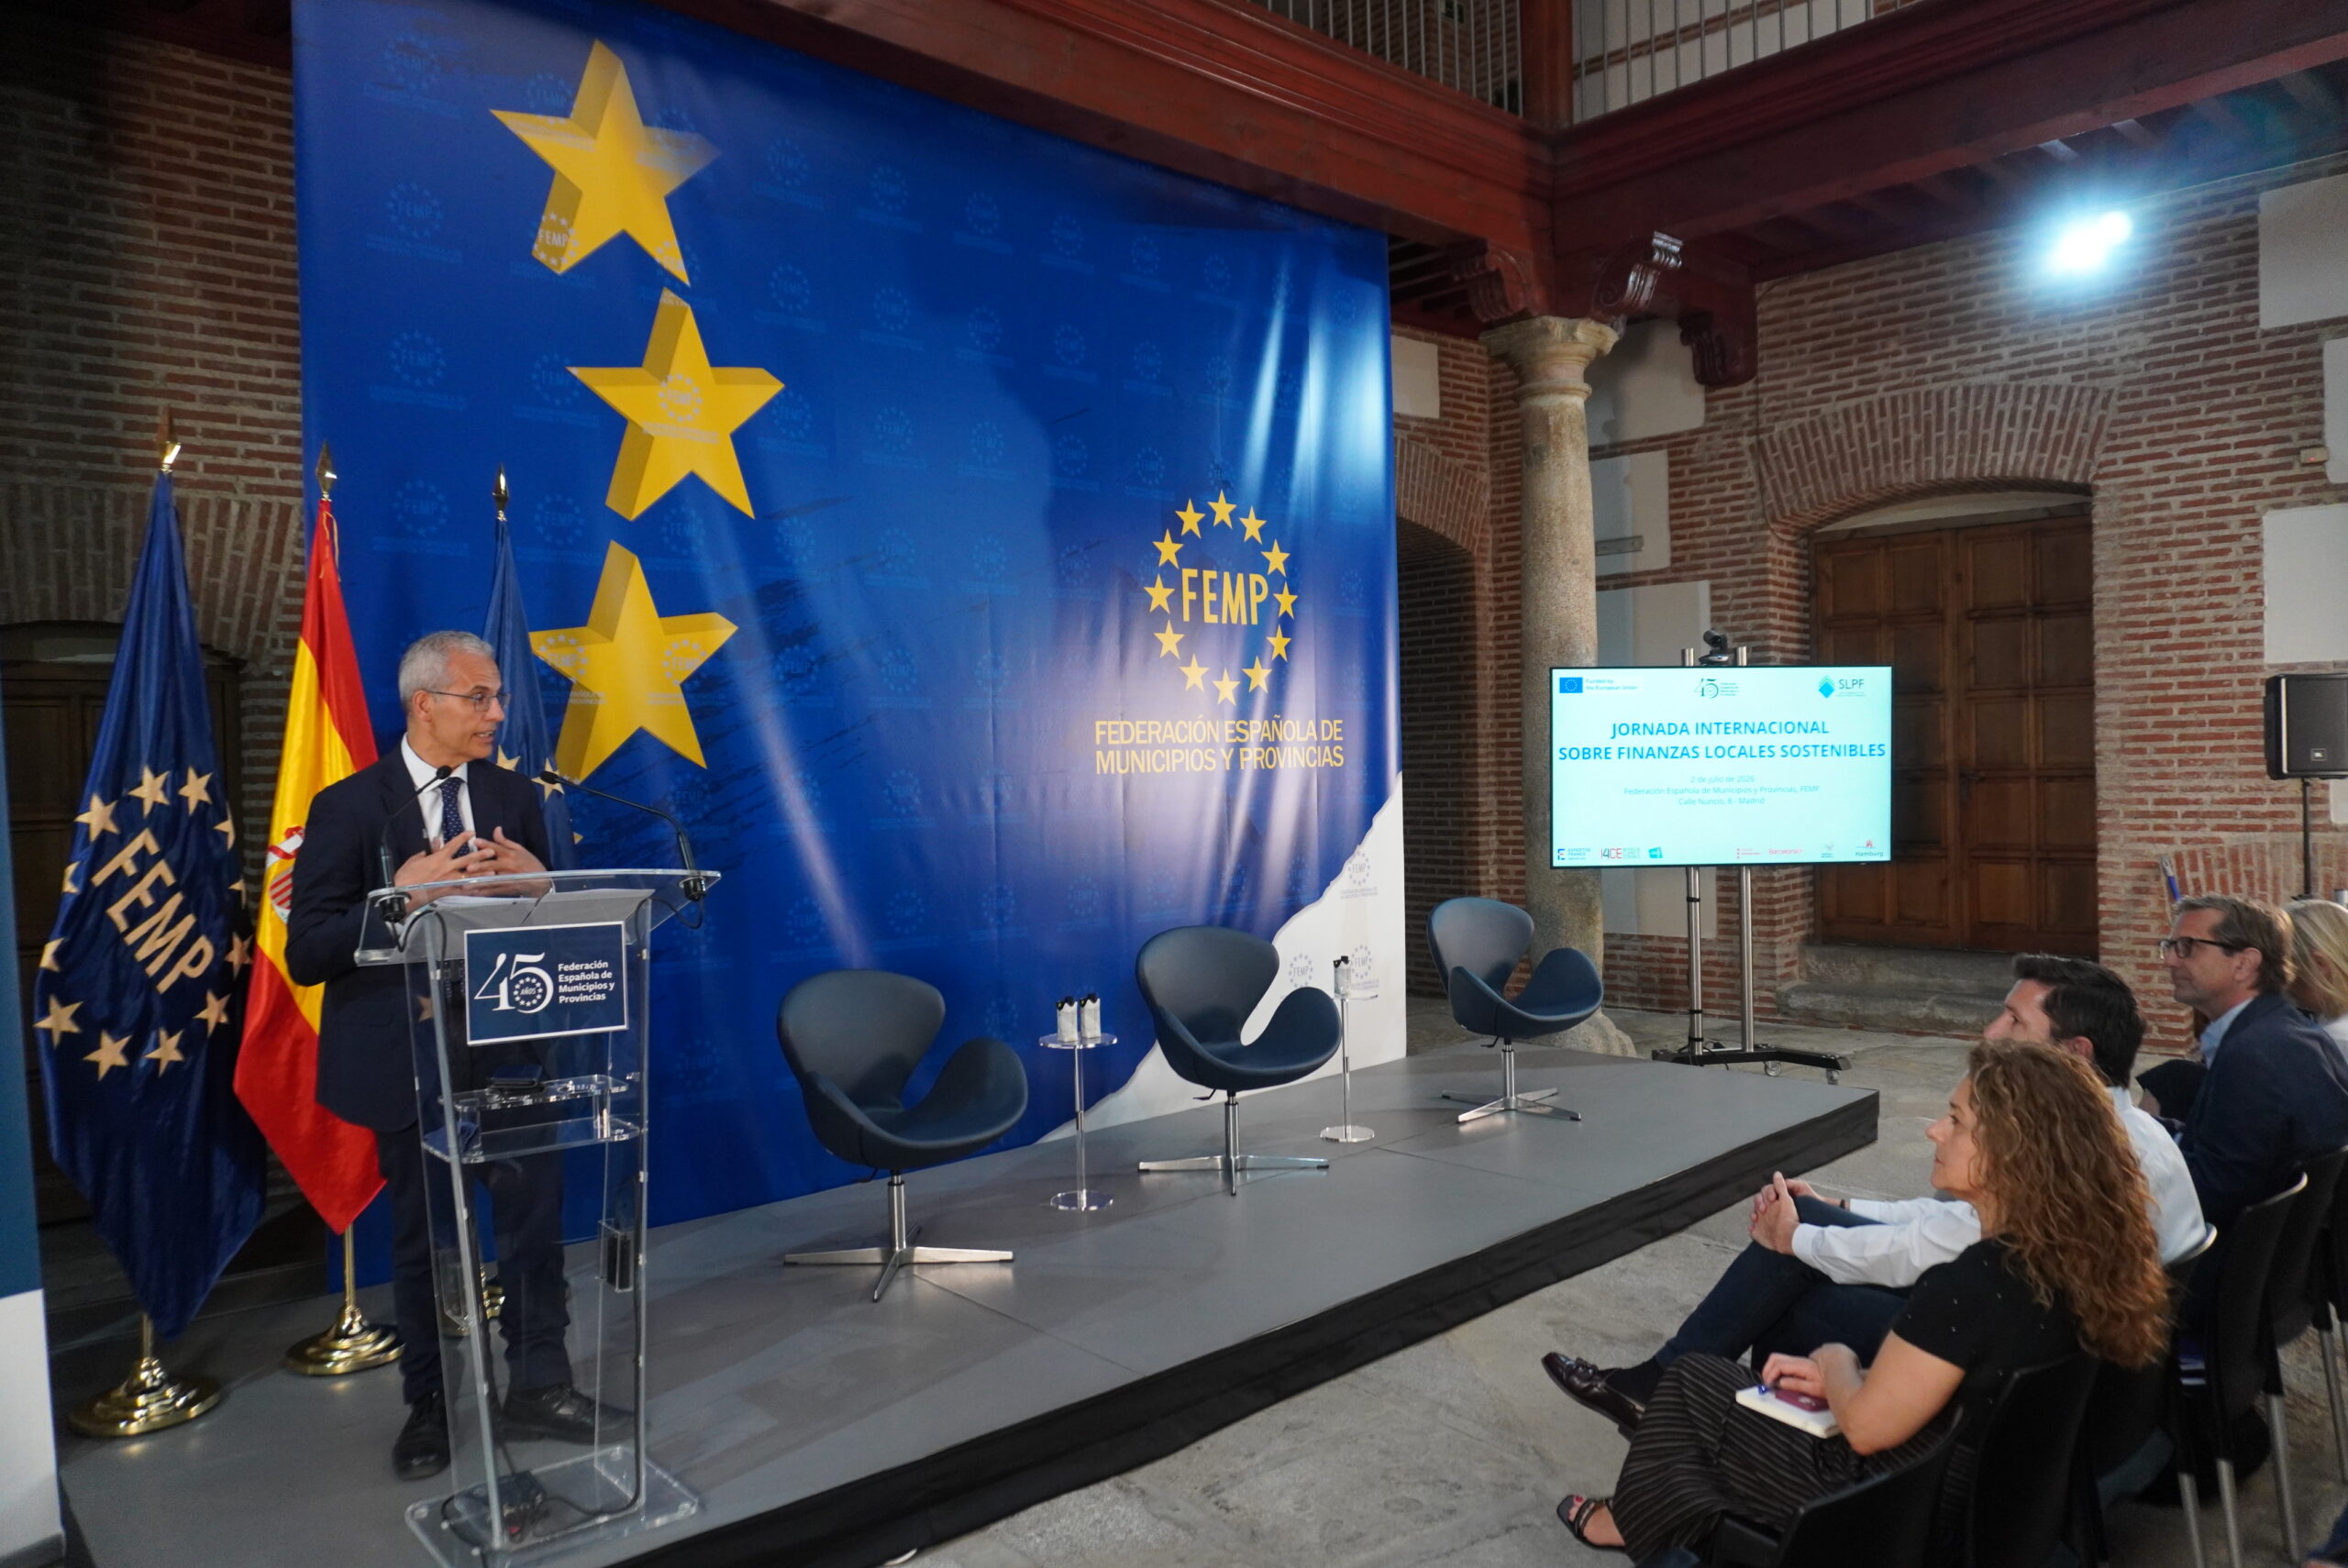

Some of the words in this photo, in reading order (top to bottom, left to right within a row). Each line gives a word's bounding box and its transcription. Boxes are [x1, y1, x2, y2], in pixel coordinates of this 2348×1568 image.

[1182, 568, 1269, 624] FEMP
[1839, 679, 1865, 690] SLPF
[1095, 714, 1219, 745] FEDERACIÓN
[1224, 714, 1318, 743] ESPAÑOLA
[1322, 720, 1344, 741] DE
[1611, 723, 1690, 739] JORNADA
[1695, 721, 1830, 734] INTERNACIONAL
[1558, 746, 1612, 760] SOBRE
[1618, 745, 1700, 759] FINANZAS
[1705, 745, 1776, 758] LOCALES
[1780, 744, 1886, 757] SOSTENIBLES
[1096, 747, 1216, 774] MUNICIPIOS
[1221, 748, 1234, 770] Y
[1240, 745, 1345, 769] PROVINCIAS
[1709, 775, 1724, 785] julio
[1623, 787, 1665, 795] Federación
[1667, 786, 1700, 796] Española
[1701, 786, 1711, 794] de
[1712, 786, 1752, 796] Municipios
[1800, 785, 1821, 793] FEMP
[1678, 797, 1696, 805] Calle
[1699, 797, 1726, 806] Nuncio,
[1739, 796, 1766, 805] Madrid
[91, 828, 215, 994] FEMP
[558, 959, 608, 972] Federación
[473, 953, 554, 1013] 45
[558, 970, 599, 984] Española
[601, 970, 613, 979] de
[520, 986, 537, 996] AÑOS
[558, 981, 608, 995] Municipios
[607, 981, 615, 992] y
[559, 992, 606, 1004] Provincias
